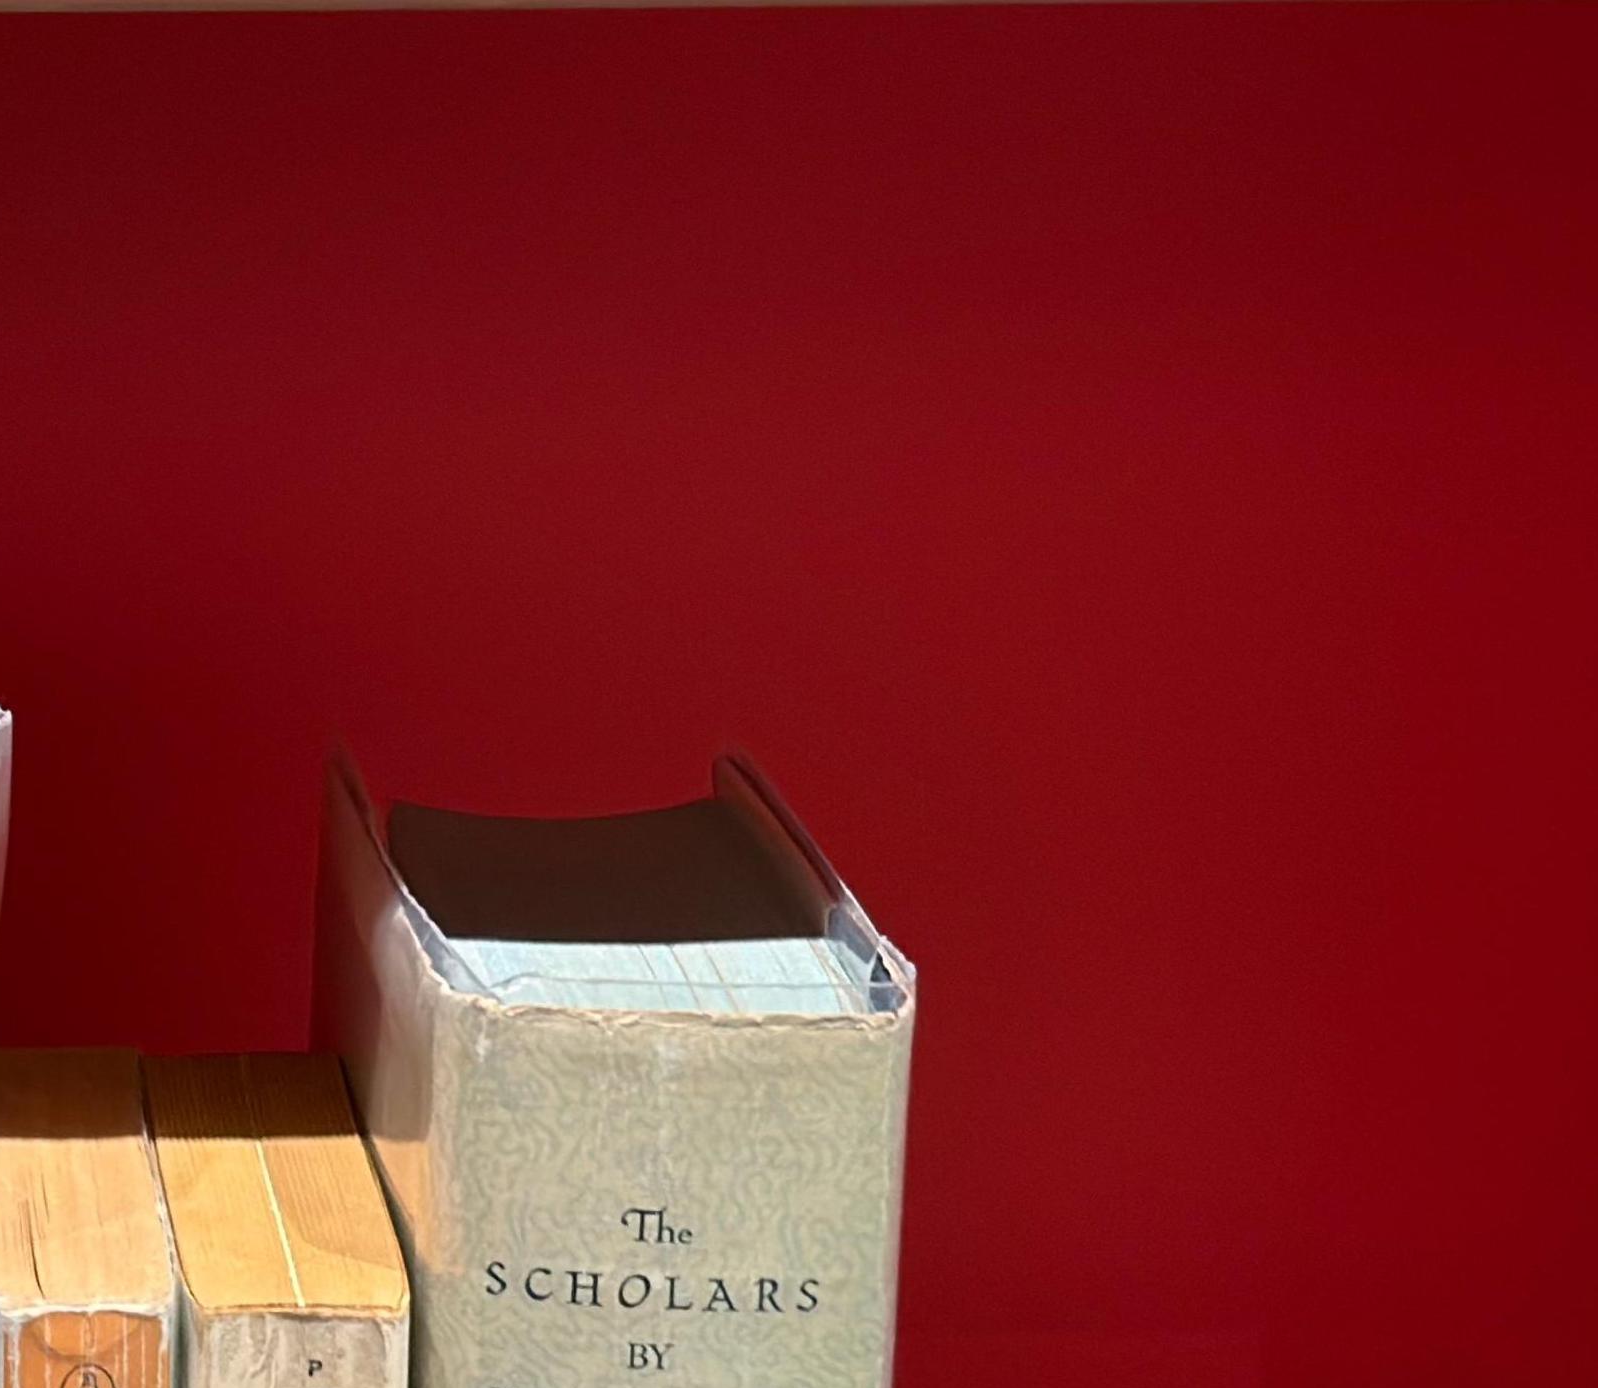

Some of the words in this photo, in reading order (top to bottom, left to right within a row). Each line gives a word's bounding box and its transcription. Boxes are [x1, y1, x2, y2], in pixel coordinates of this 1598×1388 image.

[620, 1207, 693, 1245] The
[484, 1261, 820, 1313] SCHOLARS
[307, 1360, 323, 1377] P
[627, 1343, 672, 1370] BY
